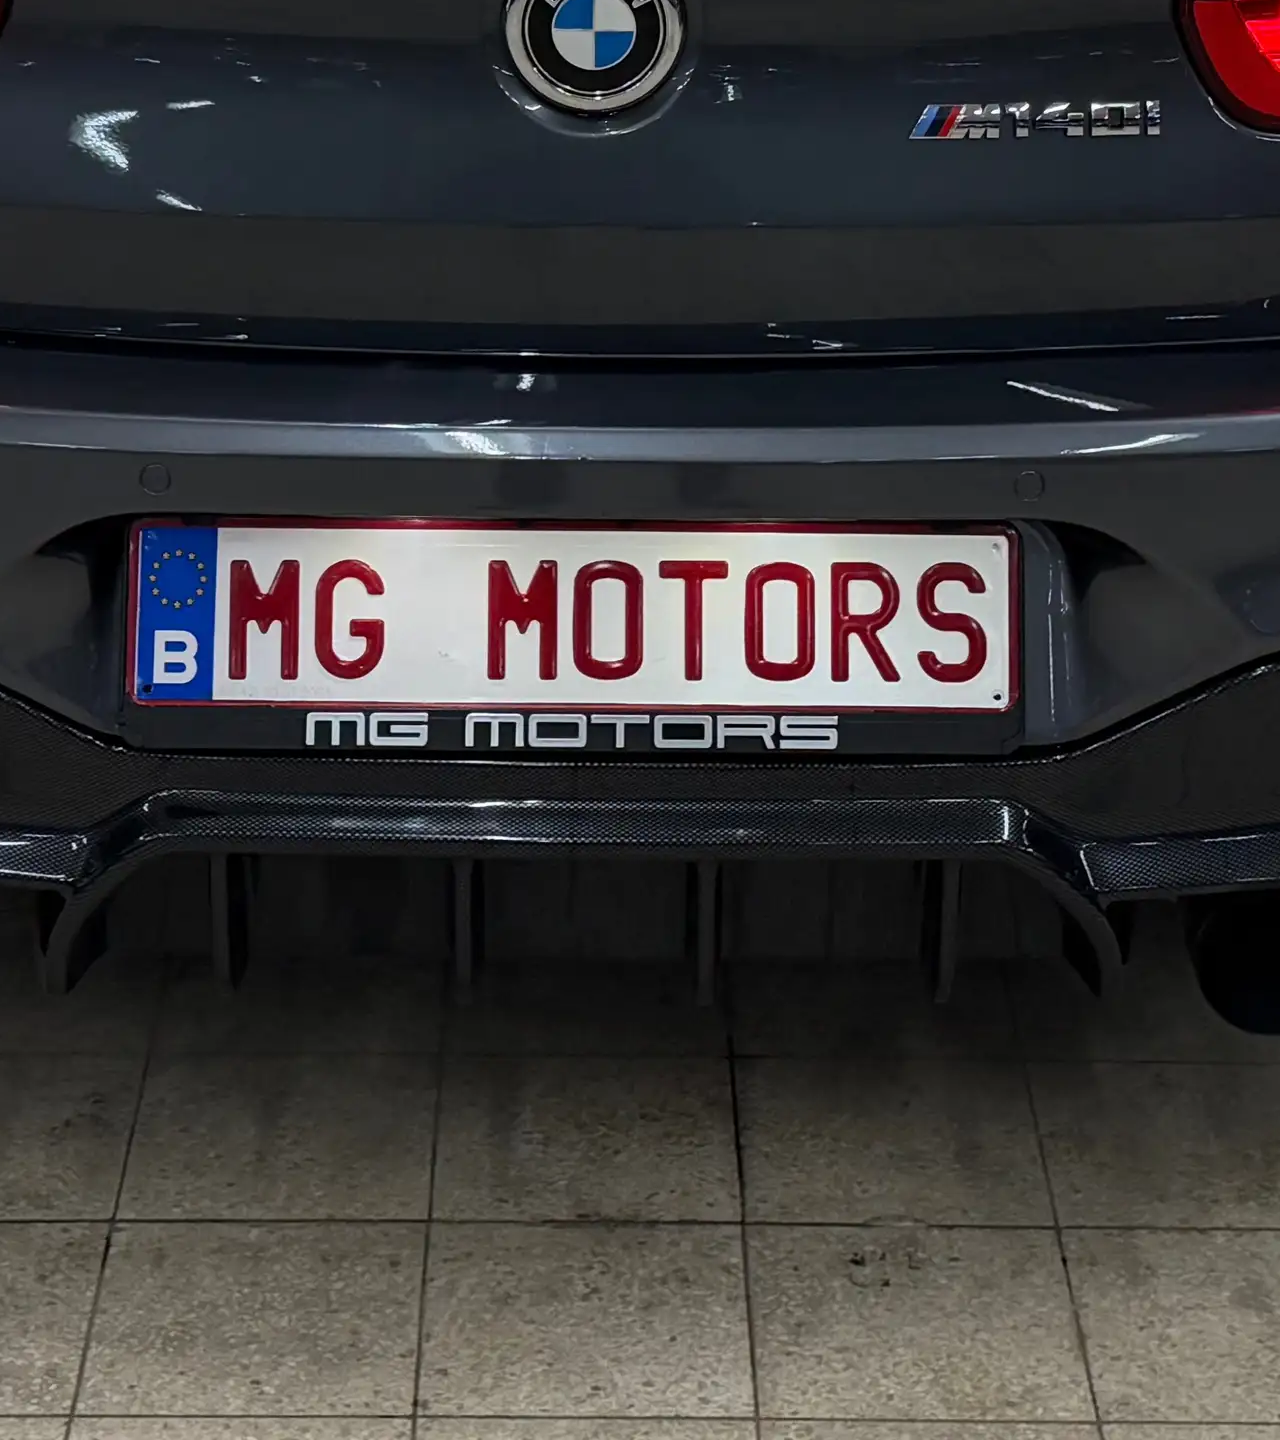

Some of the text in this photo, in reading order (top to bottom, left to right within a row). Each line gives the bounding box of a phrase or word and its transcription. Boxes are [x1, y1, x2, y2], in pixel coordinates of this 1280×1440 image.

[228, 559, 988, 683] MG MOTORS
[152, 629, 198, 684] B
[305, 711, 839, 750] MG MOTORS
